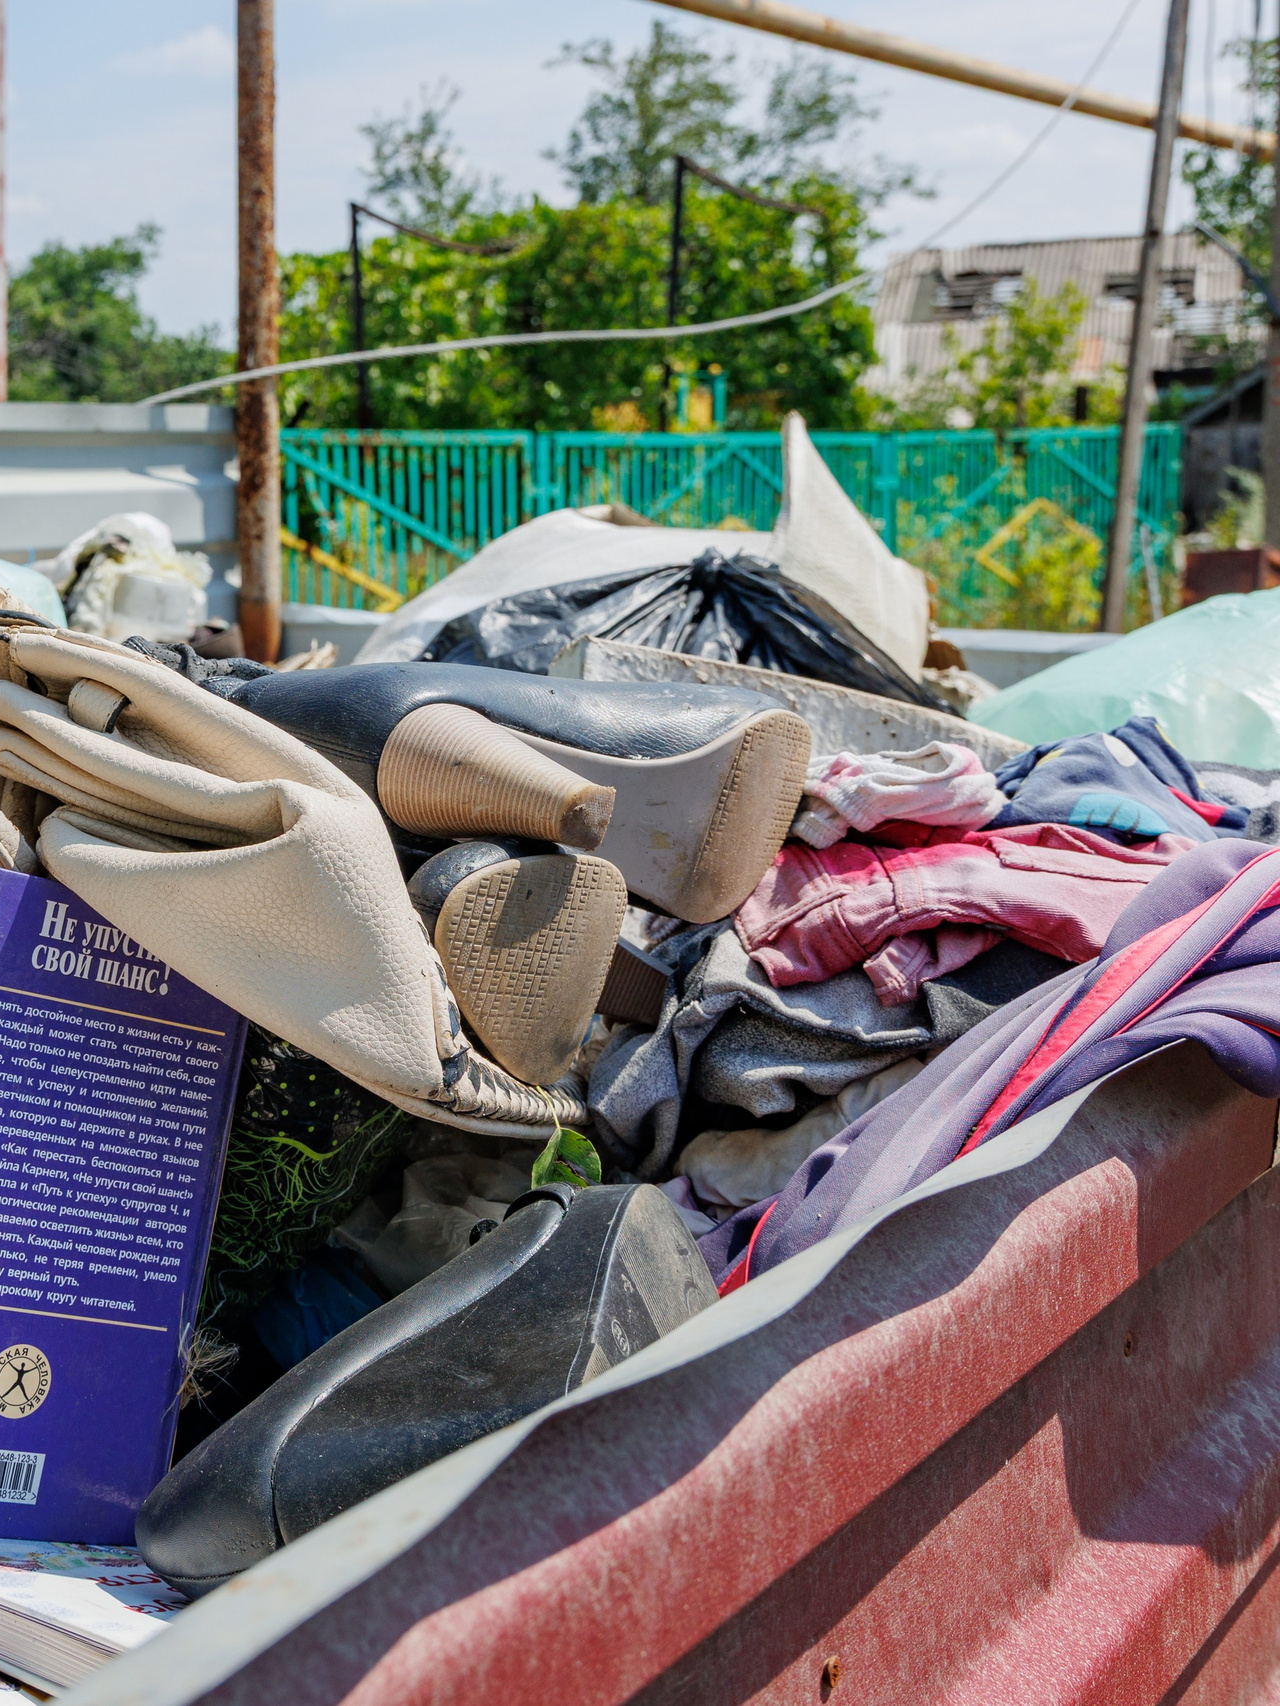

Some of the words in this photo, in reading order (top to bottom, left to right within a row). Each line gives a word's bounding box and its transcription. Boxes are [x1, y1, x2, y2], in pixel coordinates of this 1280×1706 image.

[31, 944, 94, 980] СВОЙ
[24, 1006, 82, 1025] достойное
[84, 1018, 116, 1032] место
[117, 1025, 124, 1034] в
[126, 1027, 160, 1041] жизни
[162, 1034, 183, 1046] есть
[184, 1039, 192, 1050] у
[196, 1041, 221, 1053] каж-
[28, 1042, 66, 1057] только
[67, 1050, 81, 1060] не
[82, 1053, 131, 1069] опоздать
[132, 1063, 164, 1076] найти
[165, 1068, 190, 1083] себя,
[193, 1074, 215, 1086] свое
[48, 1029, 86, 1043] может
[89, 1037, 117, 1049] стать
[122, 1043, 181, 1062] «стратегом
[185, 1056, 219, 1070] своего
[11, 1056, 46, 1070] чтобы
[50, 1064, 145, 1089] целеустремленно
[150, 1083, 176, 1095] идти
[180, 1089, 212, 1101] наме-
[26, 1077, 34, 1086] к
[37, 1079, 75, 1096] успеху
[79, 1087, 87, 1096] и
[91, 1089, 157, 1108] исполнению
[160, 1102, 208, 1118] желаний.
[9, 1109, 57, 1126] которую
[60, 1118, 76, 1128] вы
[78, 1122, 125, 1137] держите
[128, 1130, 135, 1139] в
[137, 1132, 170, 1145] руках.
[174, 1136, 181, 1147] В
[184, 1141, 203, 1151] нее
[53, 1099, 61, 1108] и
[63, 1101, 136, 1122] помощником
[138, 1115, 152, 1125] на
[154, 1118, 180, 1130] этом
[182, 1123, 206, 1135] пути
[0, 1142, 28, 1155] «Как
[32, 1148, 86, 1165] перестать
[91, 1156, 162, 1178] беспокоиться
[166, 1171, 174, 1180] и
[178, 1173, 196, 1183] на-
[81, 1139, 94, 1149] на
[99, 1143, 158, 1160] множество
[162, 1154, 199, 1167] языков
[21, 1162, 69, 1181] Карнеги,
[72, 1171, 93, 1184] «Не
[93, 1176, 130, 1190] упусти
[131, 1183, 156, 1194] свой
[157, 1187, 193, 1199] шанс!»
[20, 1181, 28, 1191] и
[31, 1182, 63, 1197] «Путь
[66, 1189, 73, 1198] к
[75, 1191, 117, 1206] успеху»
[120, 1198, 166, 1213] супругов
[170, 1204, 179, 1215] Ч.
[182, 1208, 190, 1217] и
[39, 1220, 93, 1236] осветлить
[94, 1228, 134, 1241] жизнь»
[135, 1235, 163, 1248] всем,
[165, 1240, 183, 1250] кто
[58, 1206, 139, 1226] рекомендации
[145, 1219, 187, 1234] авторов
[27, 1233, 73, 1250] Каждый
[74, 1243, 117, 1257] человек
[118, 1249, 160, 1263] рожден
[160, 1256, 180, 1266] для
[7, 1268, 50, 1282] верный
[53, 1275, 79, 1287] путь.
[33, 1254, 48, 1264] не
[53, 1257, 84, 1270] теряя
[88, 1262, 138, 1279] времени,
[143, 1270, 177, 1283] умело
[46, 1291, 77, 1306] кругу
[80, 1296, 136, 1311] читателей.
[19, 1354, 49, 1415] ЧЕЛОВЕКА
